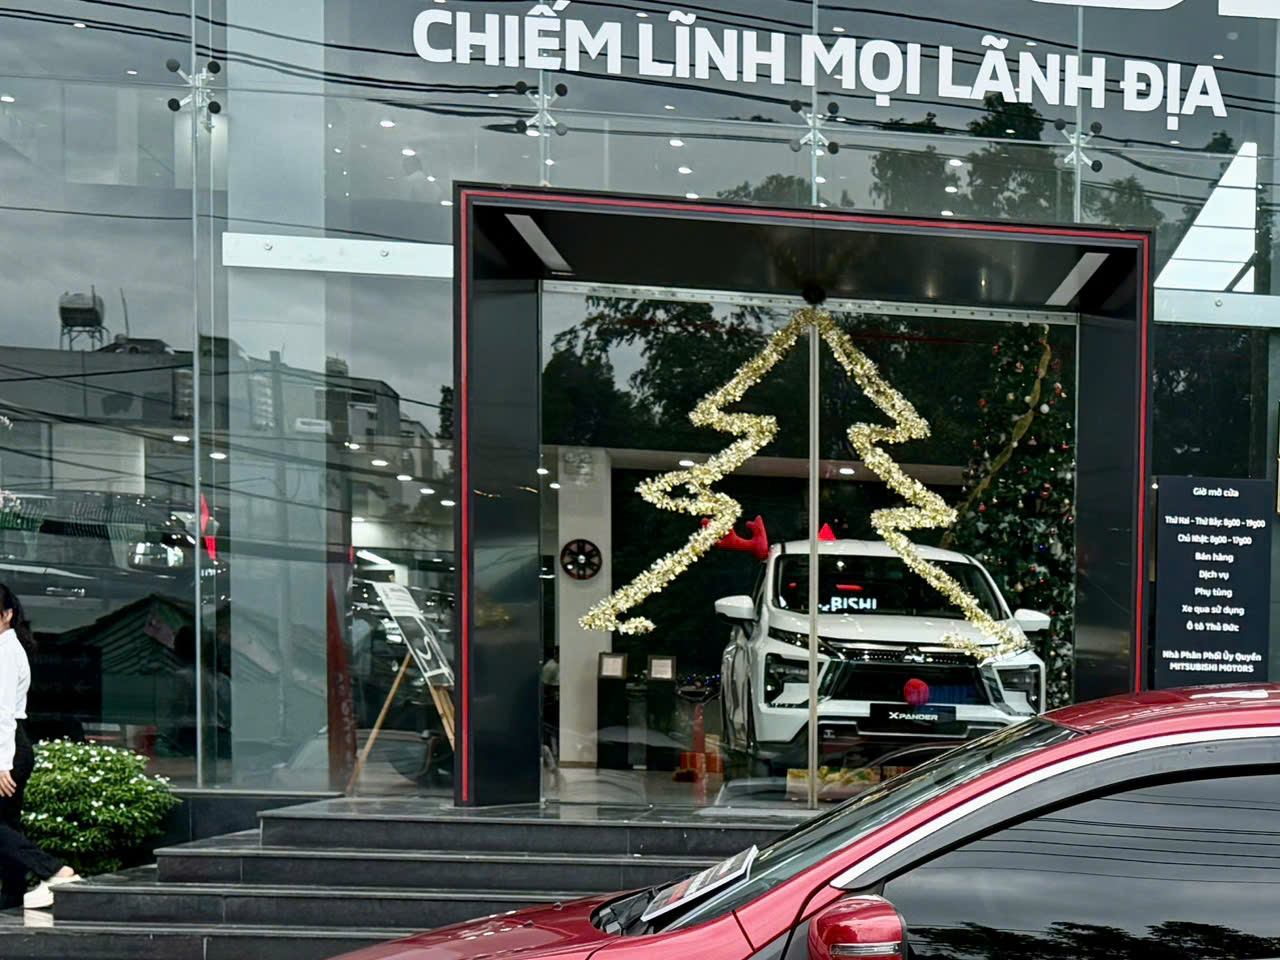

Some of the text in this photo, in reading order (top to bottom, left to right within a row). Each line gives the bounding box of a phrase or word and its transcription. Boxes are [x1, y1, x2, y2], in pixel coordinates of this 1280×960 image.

[413, 1, 1228, 131] CHIẾM LĨNH MỌI LÃNH ĐỊA
[1195, 552, 1234, 563] Bán hàng
[1199, 569, 1230, 580] Dịch vụ
[1194, 587, 1233, 598] Phụ tùng
[1181, 604, 1245, 616] Xe qua sử dụng
[1169, 662, 1254, 673] MITSUBISHI MOTORS
[888, 711, 938, 721] XPANDER
